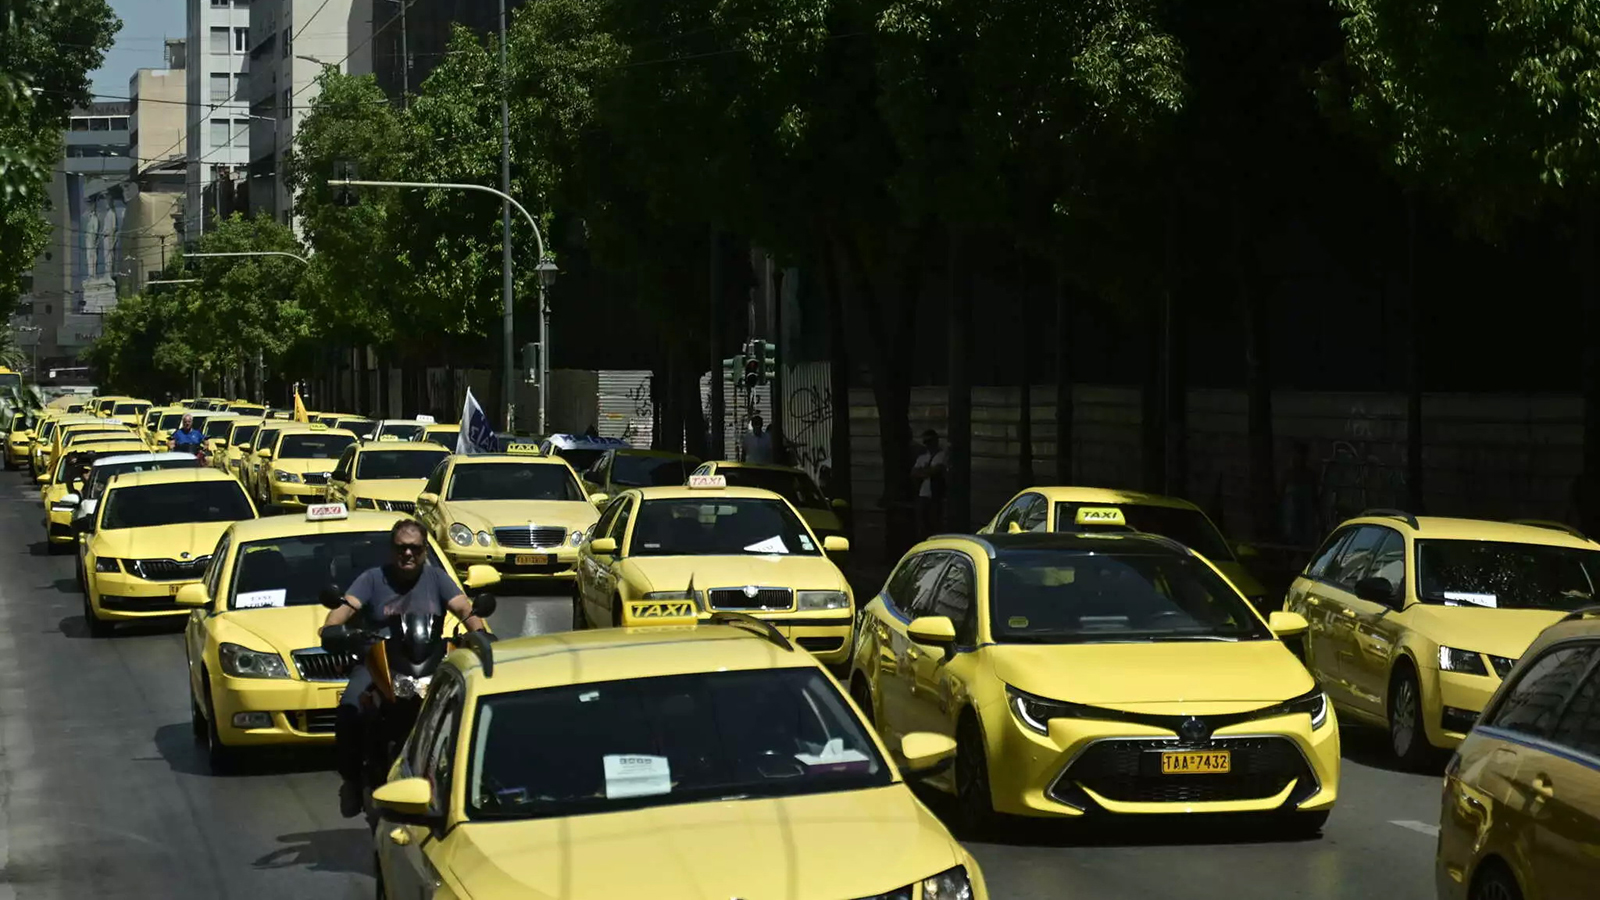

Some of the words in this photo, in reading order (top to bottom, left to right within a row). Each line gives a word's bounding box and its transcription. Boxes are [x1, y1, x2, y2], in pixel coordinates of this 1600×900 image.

[692, 477, 722, 485] TAXI
[1083, 511, 1117, 519] TAXI
[633, 604, 688, 617] TAXI
